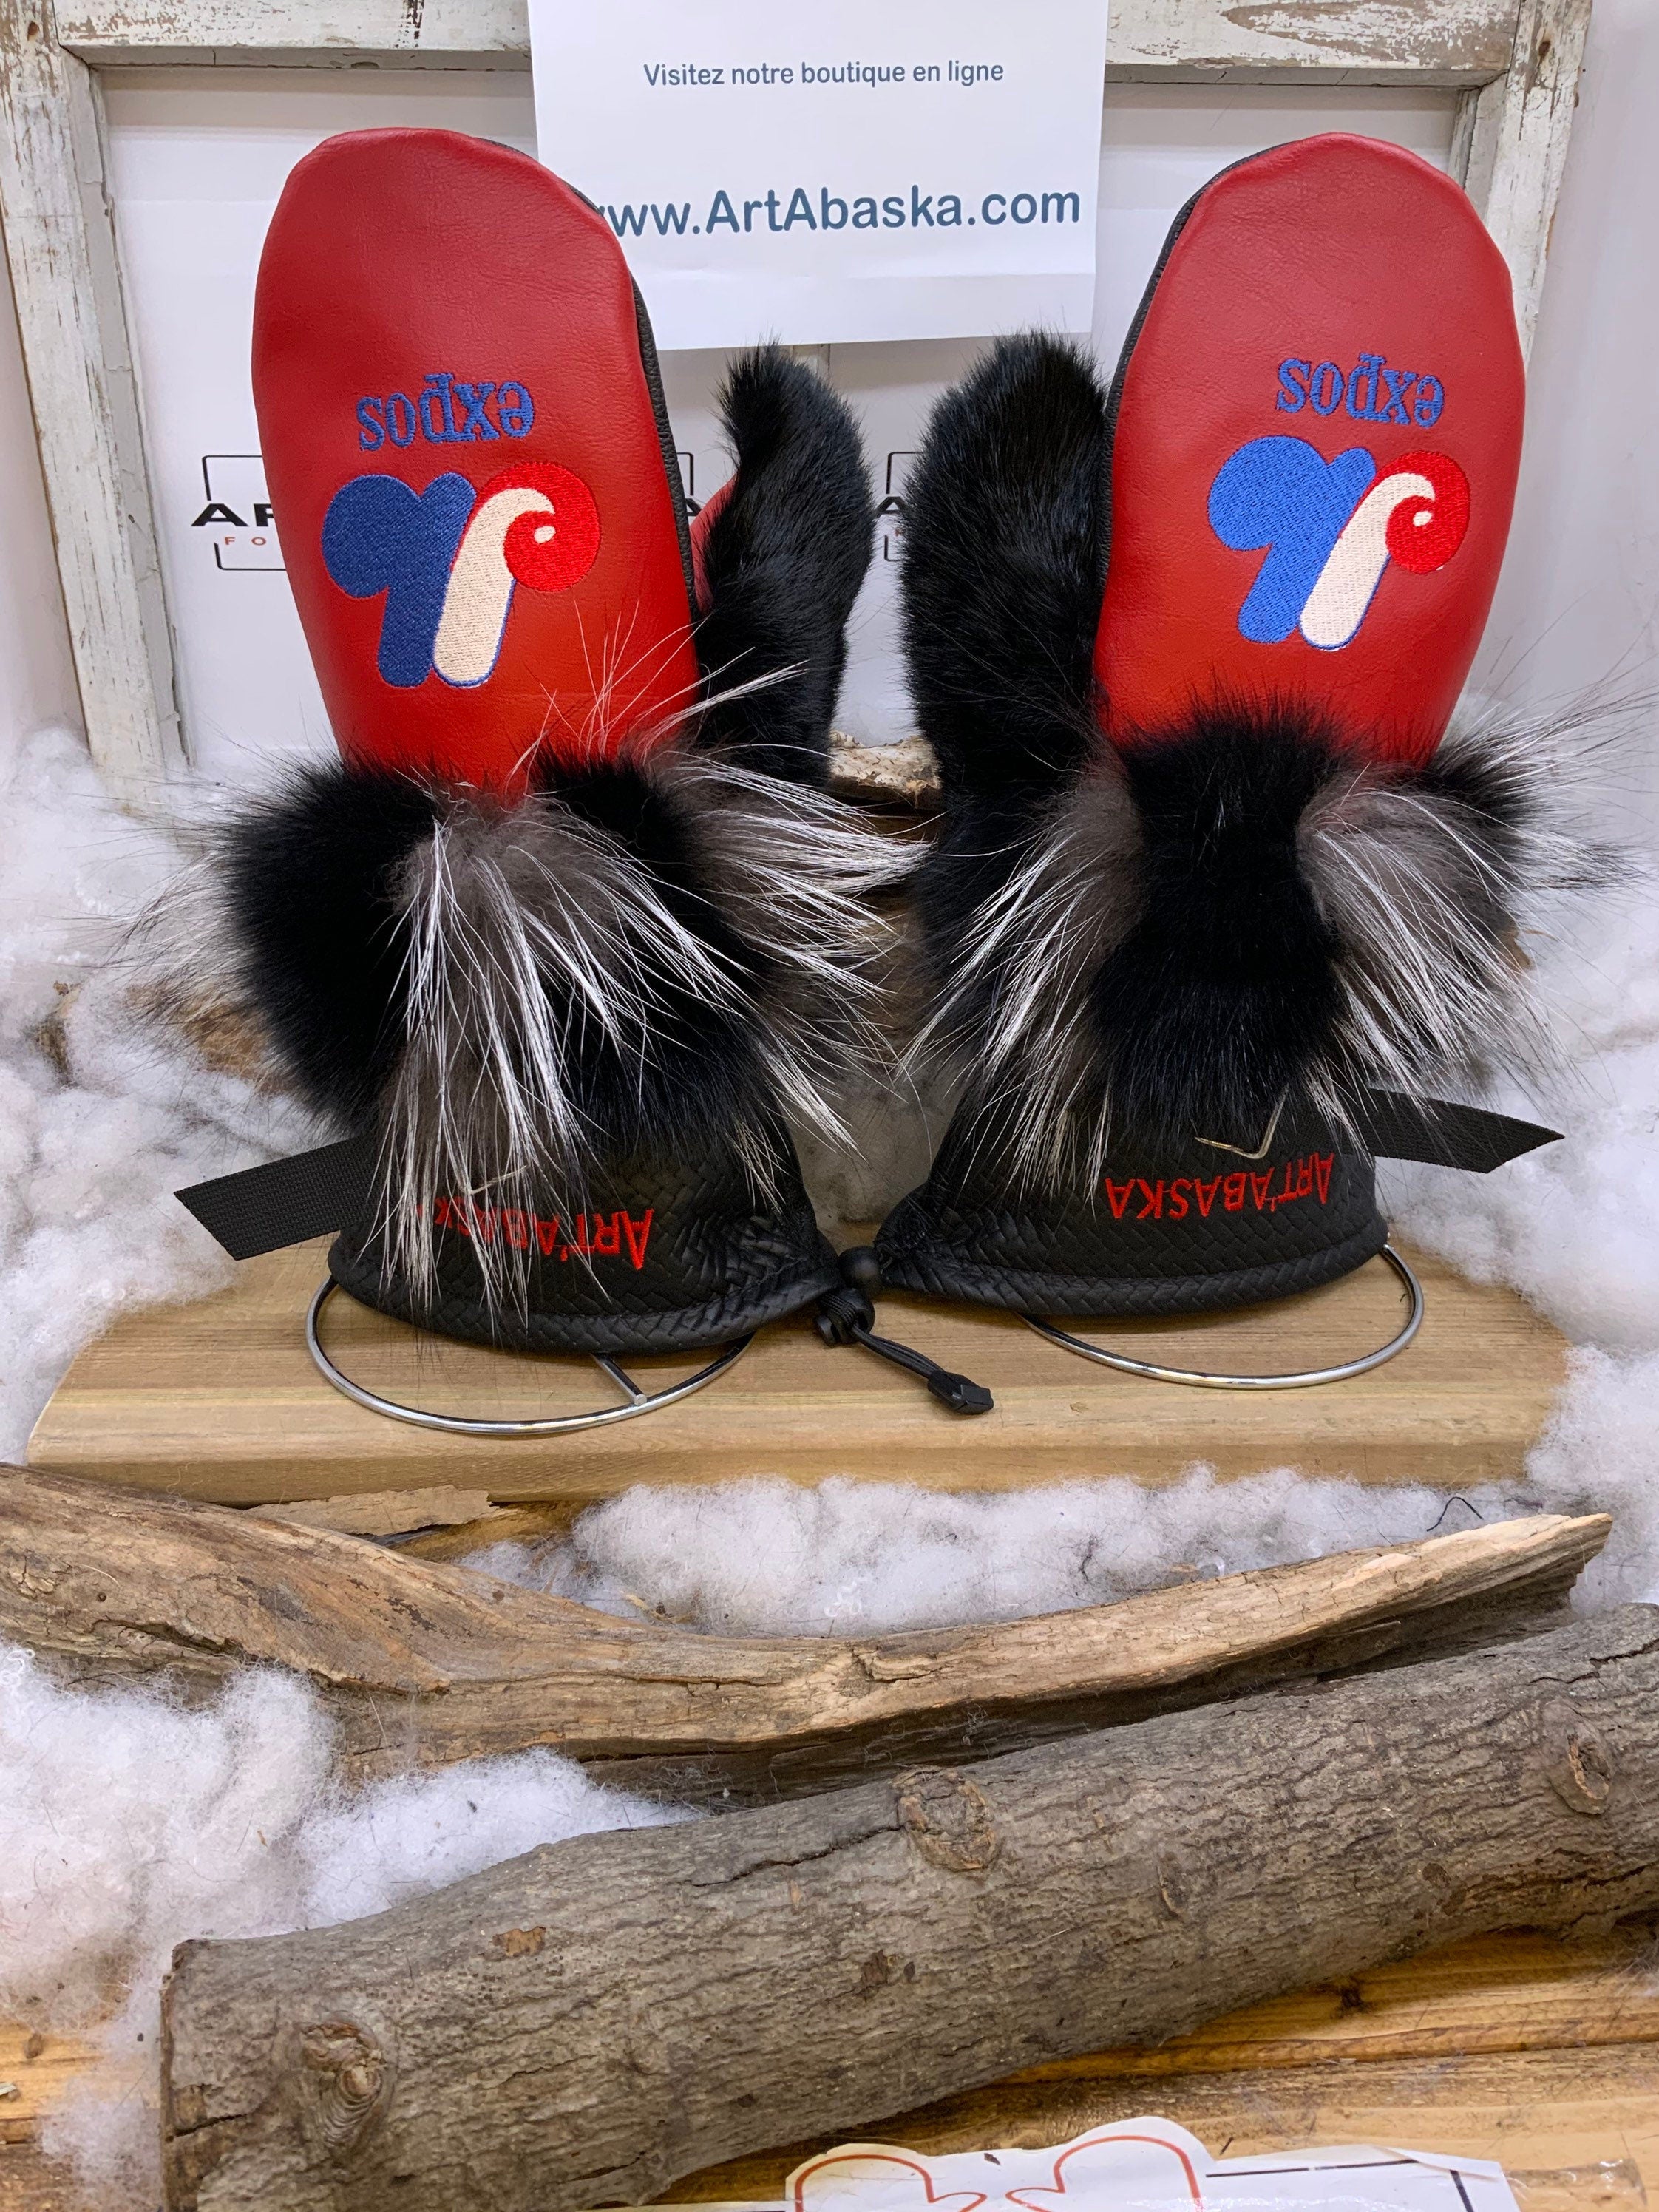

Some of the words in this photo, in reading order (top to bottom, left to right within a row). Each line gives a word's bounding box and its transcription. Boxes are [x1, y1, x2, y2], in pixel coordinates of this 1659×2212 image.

[643, 64, 725, 86] Visitez
[731, 62, 794, 85] notre
[801, 61, 906, 88] boutique
[912, 65, 940, 82] en
[948, 60, 1004, 86] ligne
[597, 184, 1080, 237] ww.ArtAbaska.com
[356, 372, 535, 451] expos
[1276, 353, 1445, 428] expos
